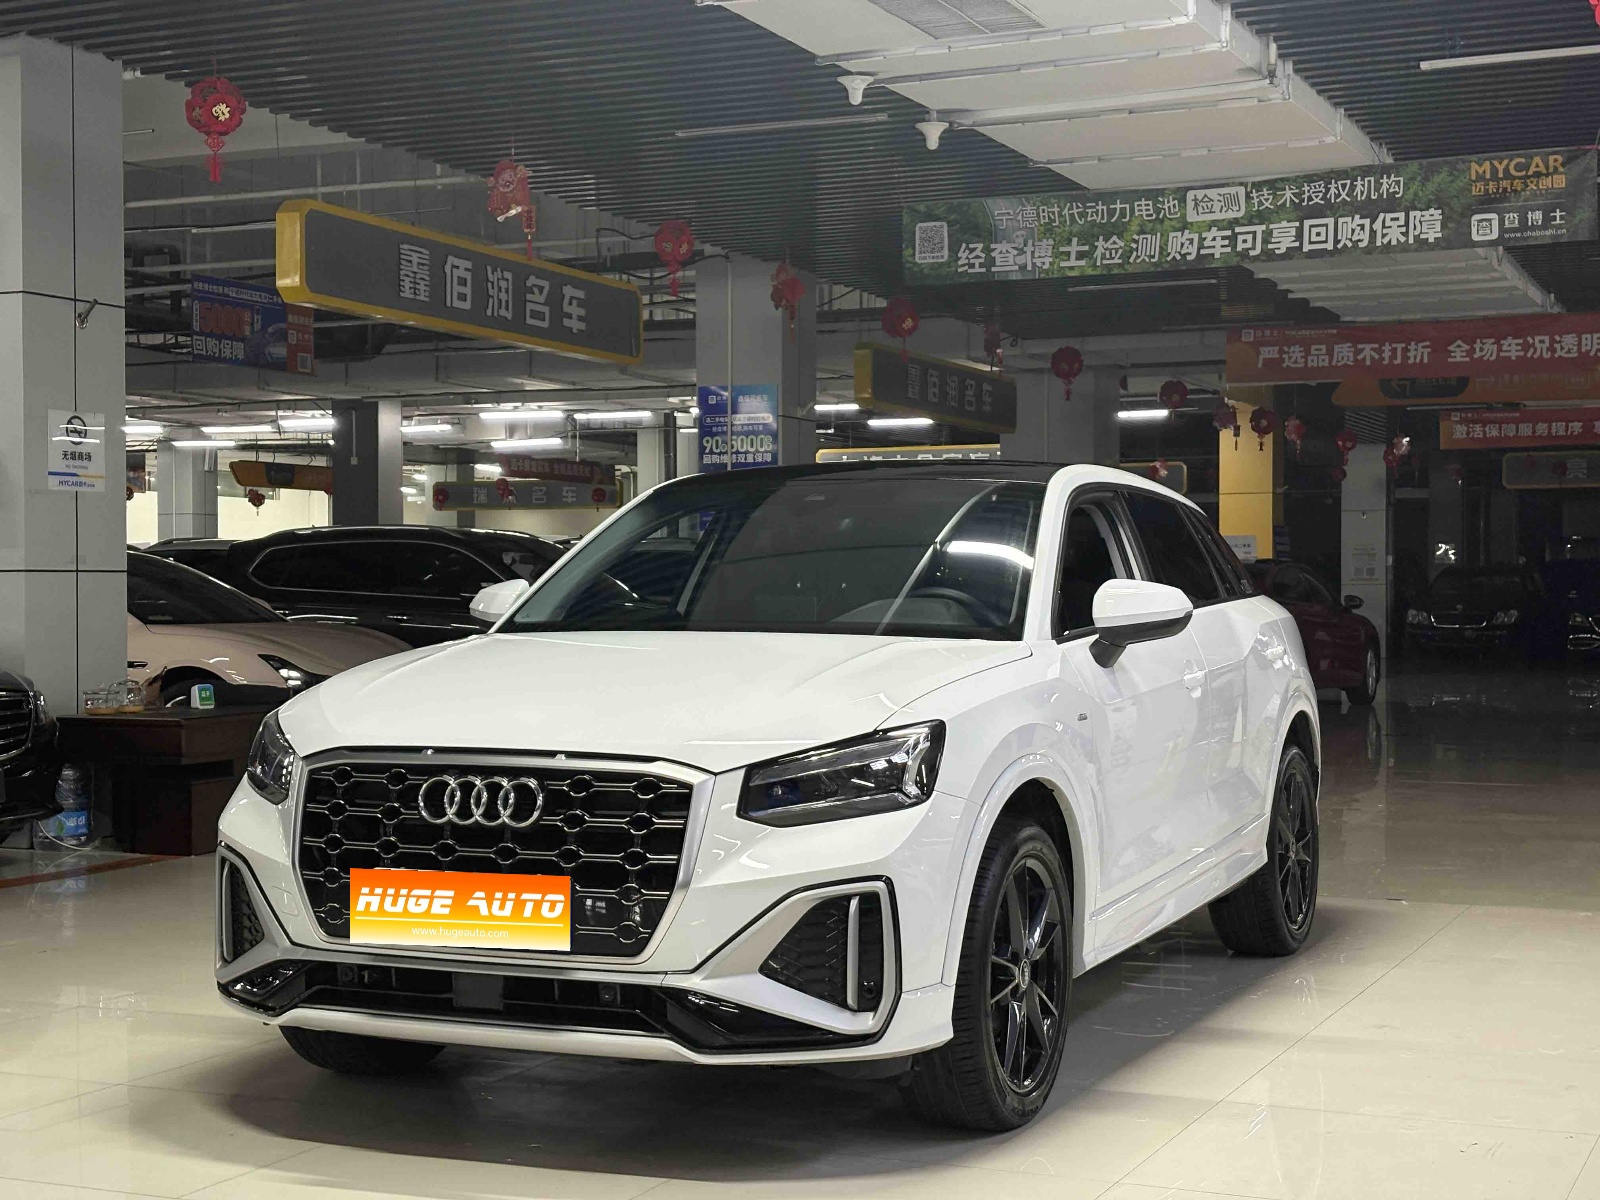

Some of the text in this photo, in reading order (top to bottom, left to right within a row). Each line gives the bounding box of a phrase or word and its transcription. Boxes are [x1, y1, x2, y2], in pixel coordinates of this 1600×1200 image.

[1470, 155, 1565, 180] MYCAR
[1471, 174, 1567, 196] 迈卡汽车文创园
[994, 173, 1404, 231] 宁德时代动力电池 检测 技术授权机构
[1503, 208, 1567, 229] 查博士
[1503, 227, 1568, 239] www.chaboshi.cn
[399, 243, 587, 334] 鑫佰润名车
[193, 335, 245, 360] 回购保障
[1257, 333, 1600, 369] 严选品质不打折 全场车况透明
[1452, 421, 1584, 439] 激活保障服务程序
[62, 450, 92, 462] 无烟商场
